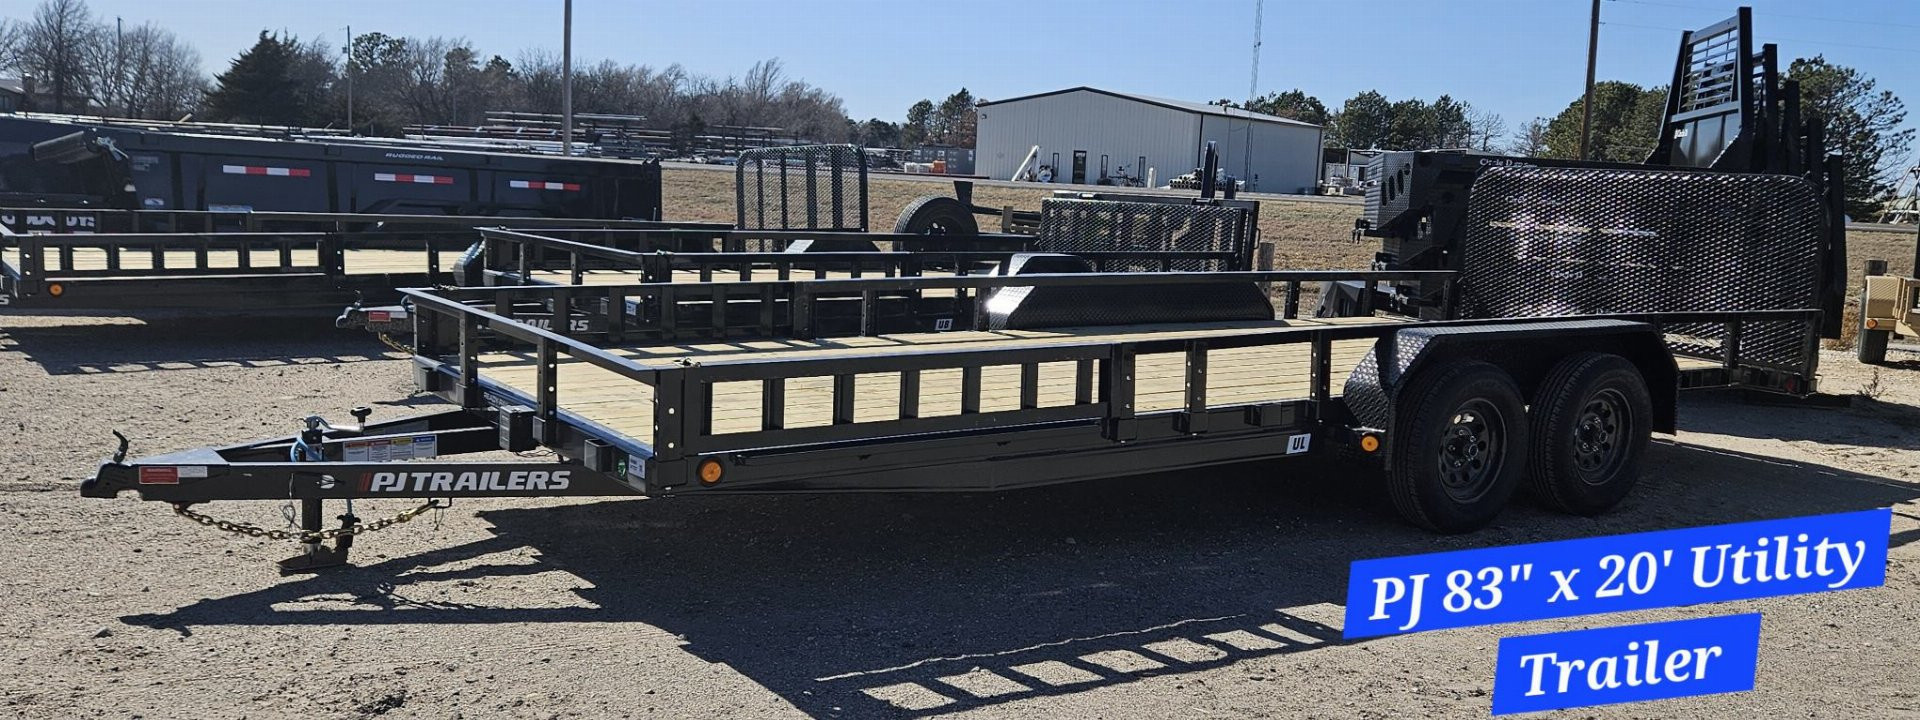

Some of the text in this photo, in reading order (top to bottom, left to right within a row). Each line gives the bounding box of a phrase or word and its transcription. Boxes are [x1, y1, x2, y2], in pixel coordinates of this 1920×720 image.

[1293, 436, 1305, 450] UL
[370, 470, 571, 492] PJ TRAILERS
